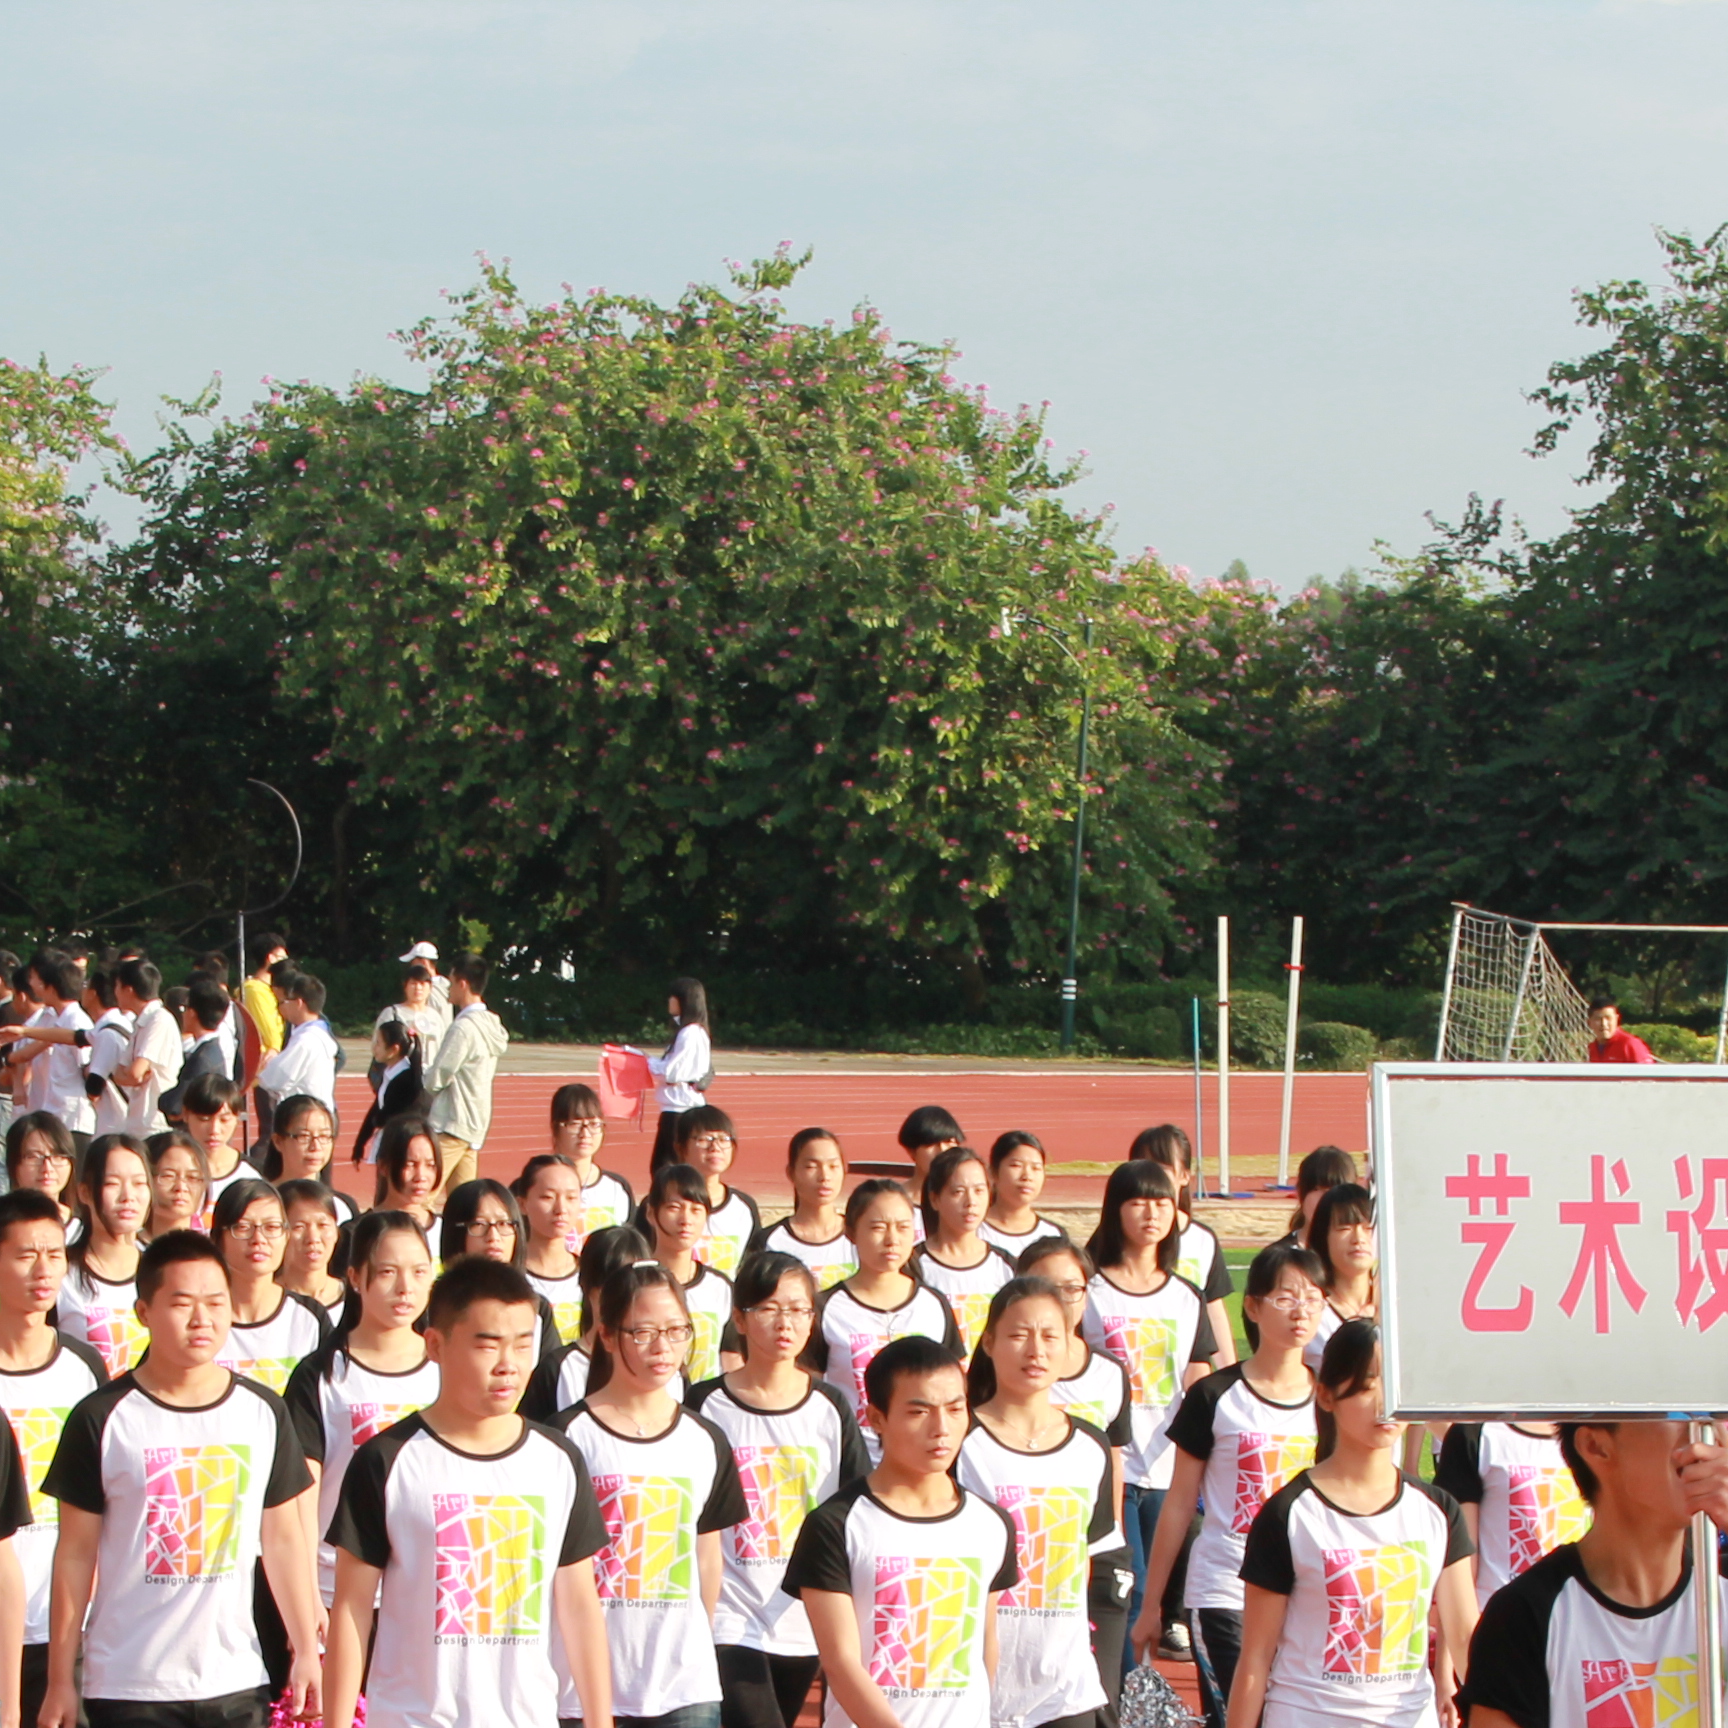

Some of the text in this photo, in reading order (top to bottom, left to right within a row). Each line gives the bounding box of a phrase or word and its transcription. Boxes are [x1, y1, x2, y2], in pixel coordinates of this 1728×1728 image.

[145, 1448, 177, 1463] Art
[593, 1476, 623, 1490] Art
[995, 1486, 1026, 1500] Art
[433, 1495, 469, 1511] Art
[735, 1557, 767, 1567] Design
[1323, 1550, 1357, 1564] Art
[875, 1557, 908, 1572] Art
[145, 1575, 184, 1586] Design
[1115, 1576, 1135, 1600] 7
[600, 1599, 687, 1610] sign Department
[997, 1607, 1027, 1617] esign
[434, 1634, 539, 1647] Design Department
[1322, 1672, 1362, 1684] Design
[1583, 1661, 1632, 1683] Art
[883, 1687, 909, 1699] sign
